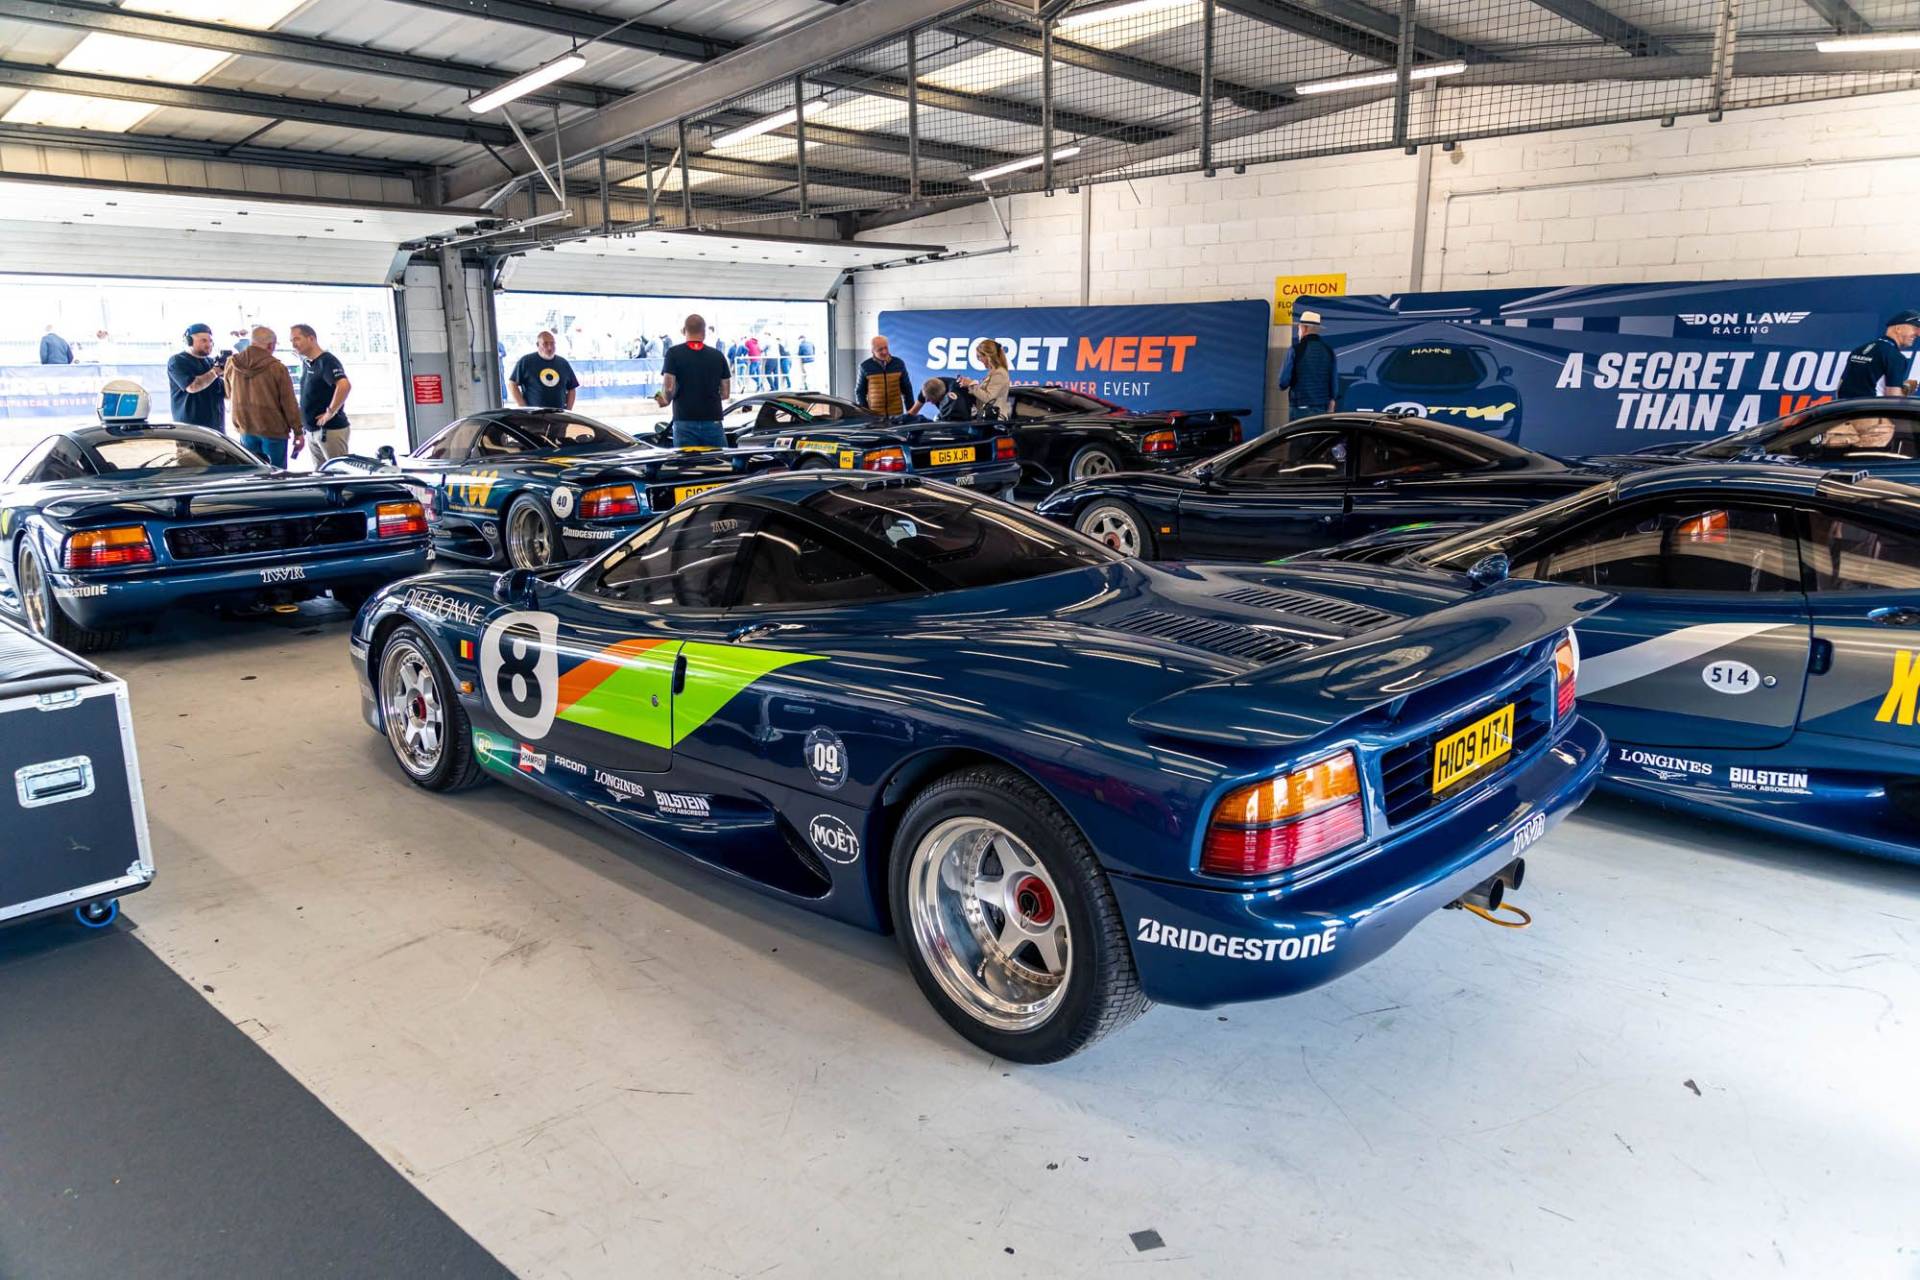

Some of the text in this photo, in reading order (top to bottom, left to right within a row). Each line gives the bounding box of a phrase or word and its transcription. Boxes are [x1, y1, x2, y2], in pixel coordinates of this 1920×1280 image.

[1282, 283, 1338, 295] CAUTION
[1278, 301, 1293, 309] FLO
[1695, 312, 1791, 325] DON LAW
[1713, 326, 1769, 334] RACING
[926, 336, 1197, 372] SECRET MEET
[1555, 352, 1584, 389] A
[1594, 351, 1754, 390] SECRET
[1103, 382, 1150, 396] EVENT
[1616, 393, 1725, 431] THAN
[1728, 394, 1761, 431] A
[938, 449, 969, 463] G15 XJR
[556, 496, 568, 508] 40
[562, 526, 616, 540] BRIDGESTONE
[261, 566, 306, 583] TWR
[497, 622, 542, 718] 8
[1711, 667, 1750, 686] 514
[1437, 712, 1510, 784] H109 HTA
[521, 752, 546, 769] CHAMPION
[554, 755, 587, 775] FACOM
[813, 743, 841, 774] 09
[1620, 749, 1713, 775] LONGINES
[594, 769, 645, 798] LONGINES
[1729, 767, 1808, 788] BILSTEIN
[1731, 782, 1757, 791] SHOCK
[653, 790, 710, 810] BILSTEIN
[659, 806, 710, 817] SHOCK ABSORBERS
[813, 822, 856, 855] MOËT
[1512, 812, 1546, 856] TWR
[1136, 917, 1337, 961] BRIDGESTONE
